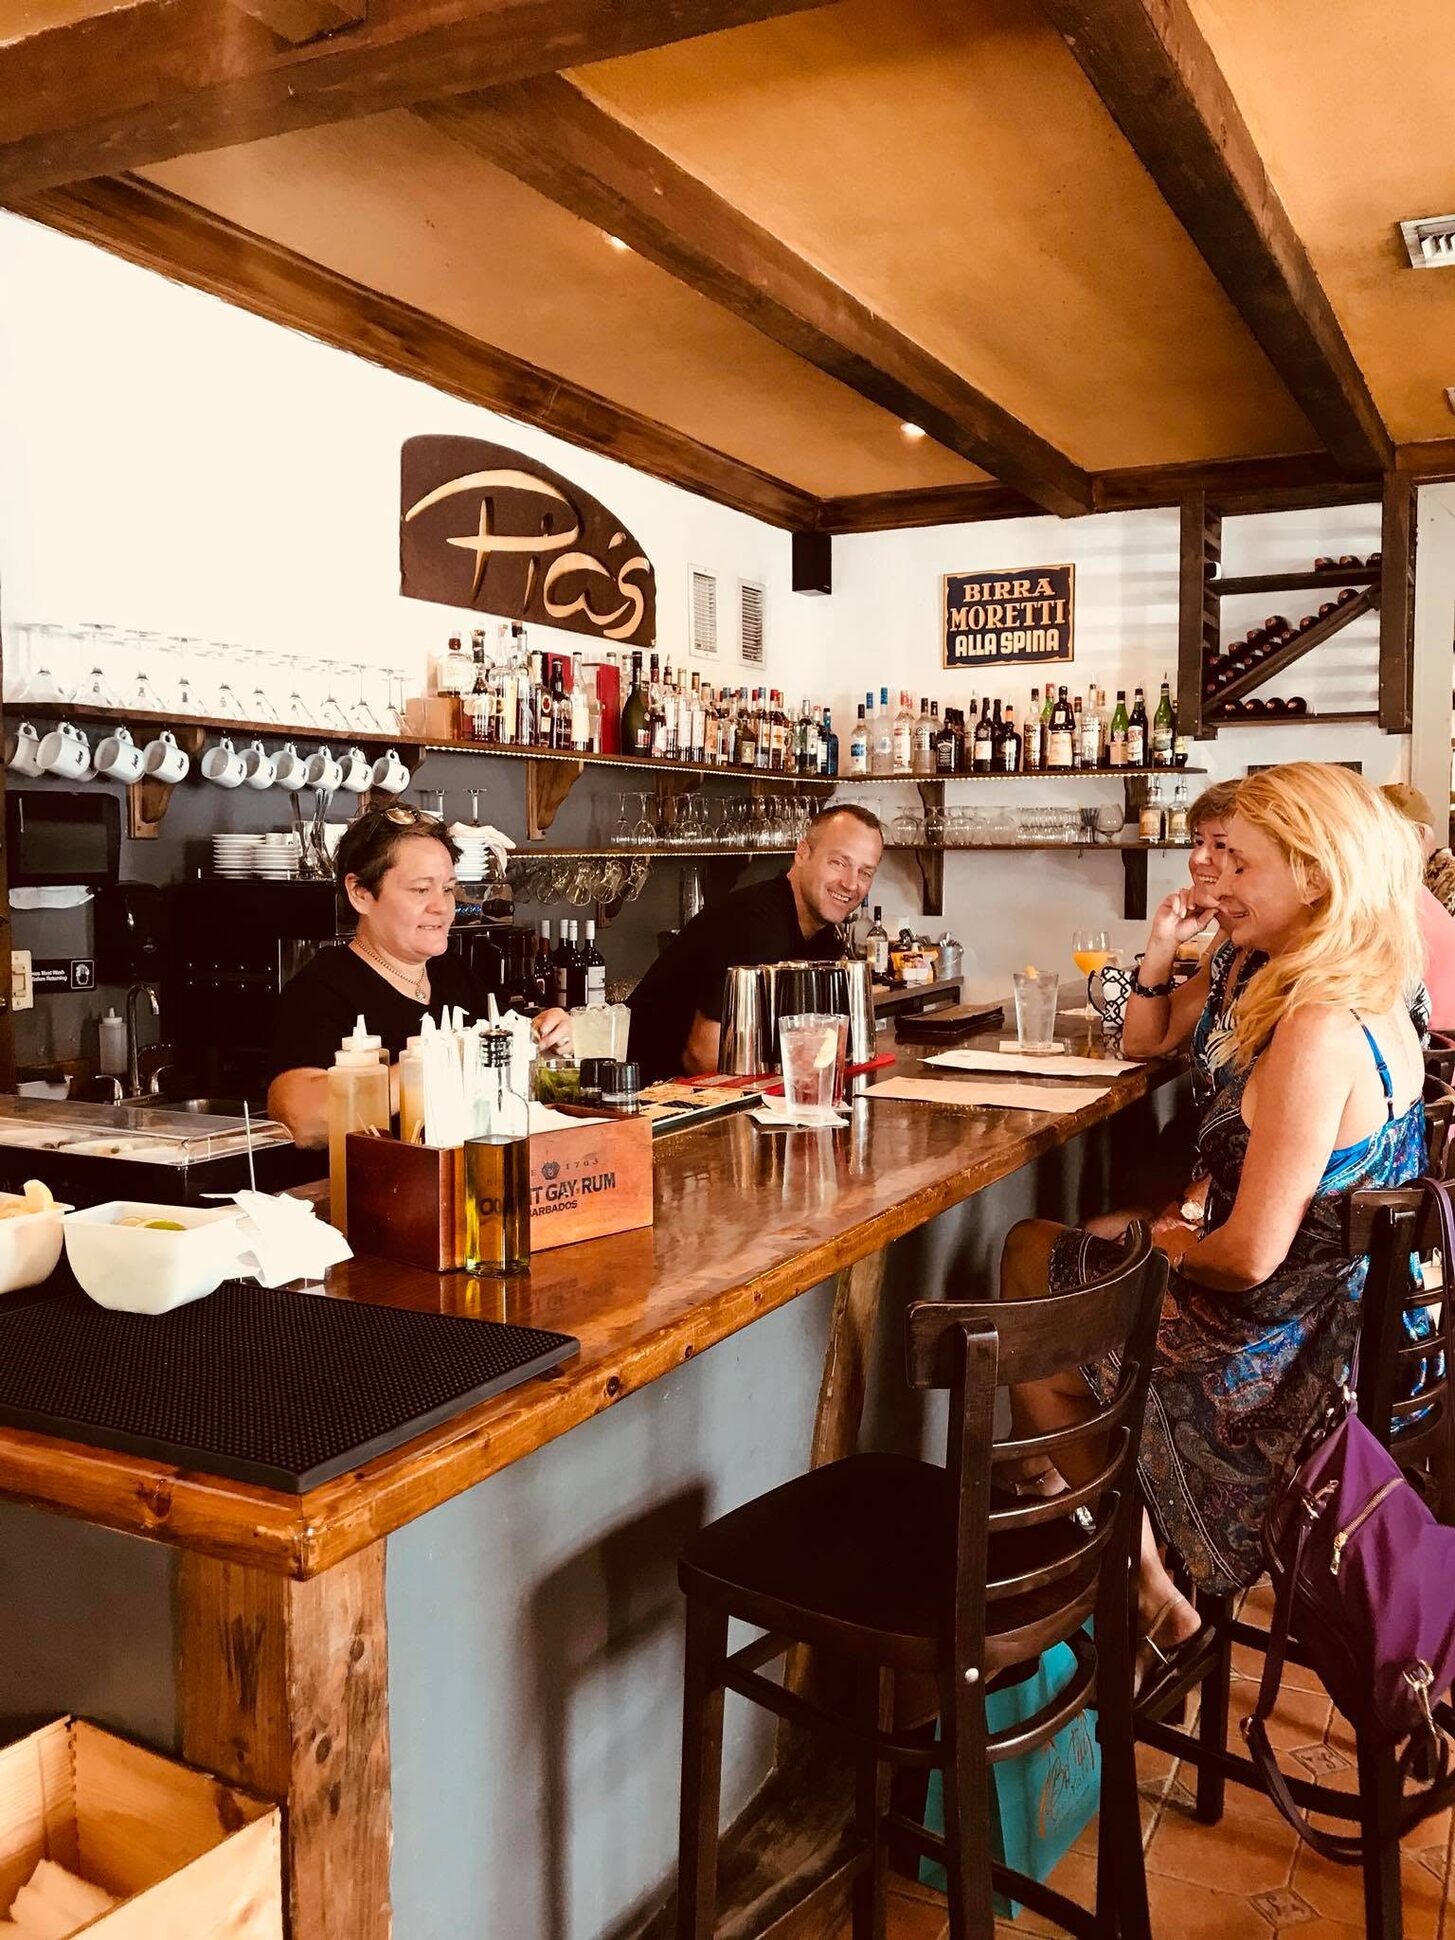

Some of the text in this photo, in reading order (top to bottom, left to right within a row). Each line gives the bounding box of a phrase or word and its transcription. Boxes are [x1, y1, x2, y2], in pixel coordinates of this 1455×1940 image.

[404, 469, 651, 640] Pia's
[963, 578, 1055, 602] BIRRA
[949, 599, 1066, 632] MORETTI
[955, 629, 1060, 657] ALLA SPINA
[530, 1200, 578, 1217] ARBADOS
